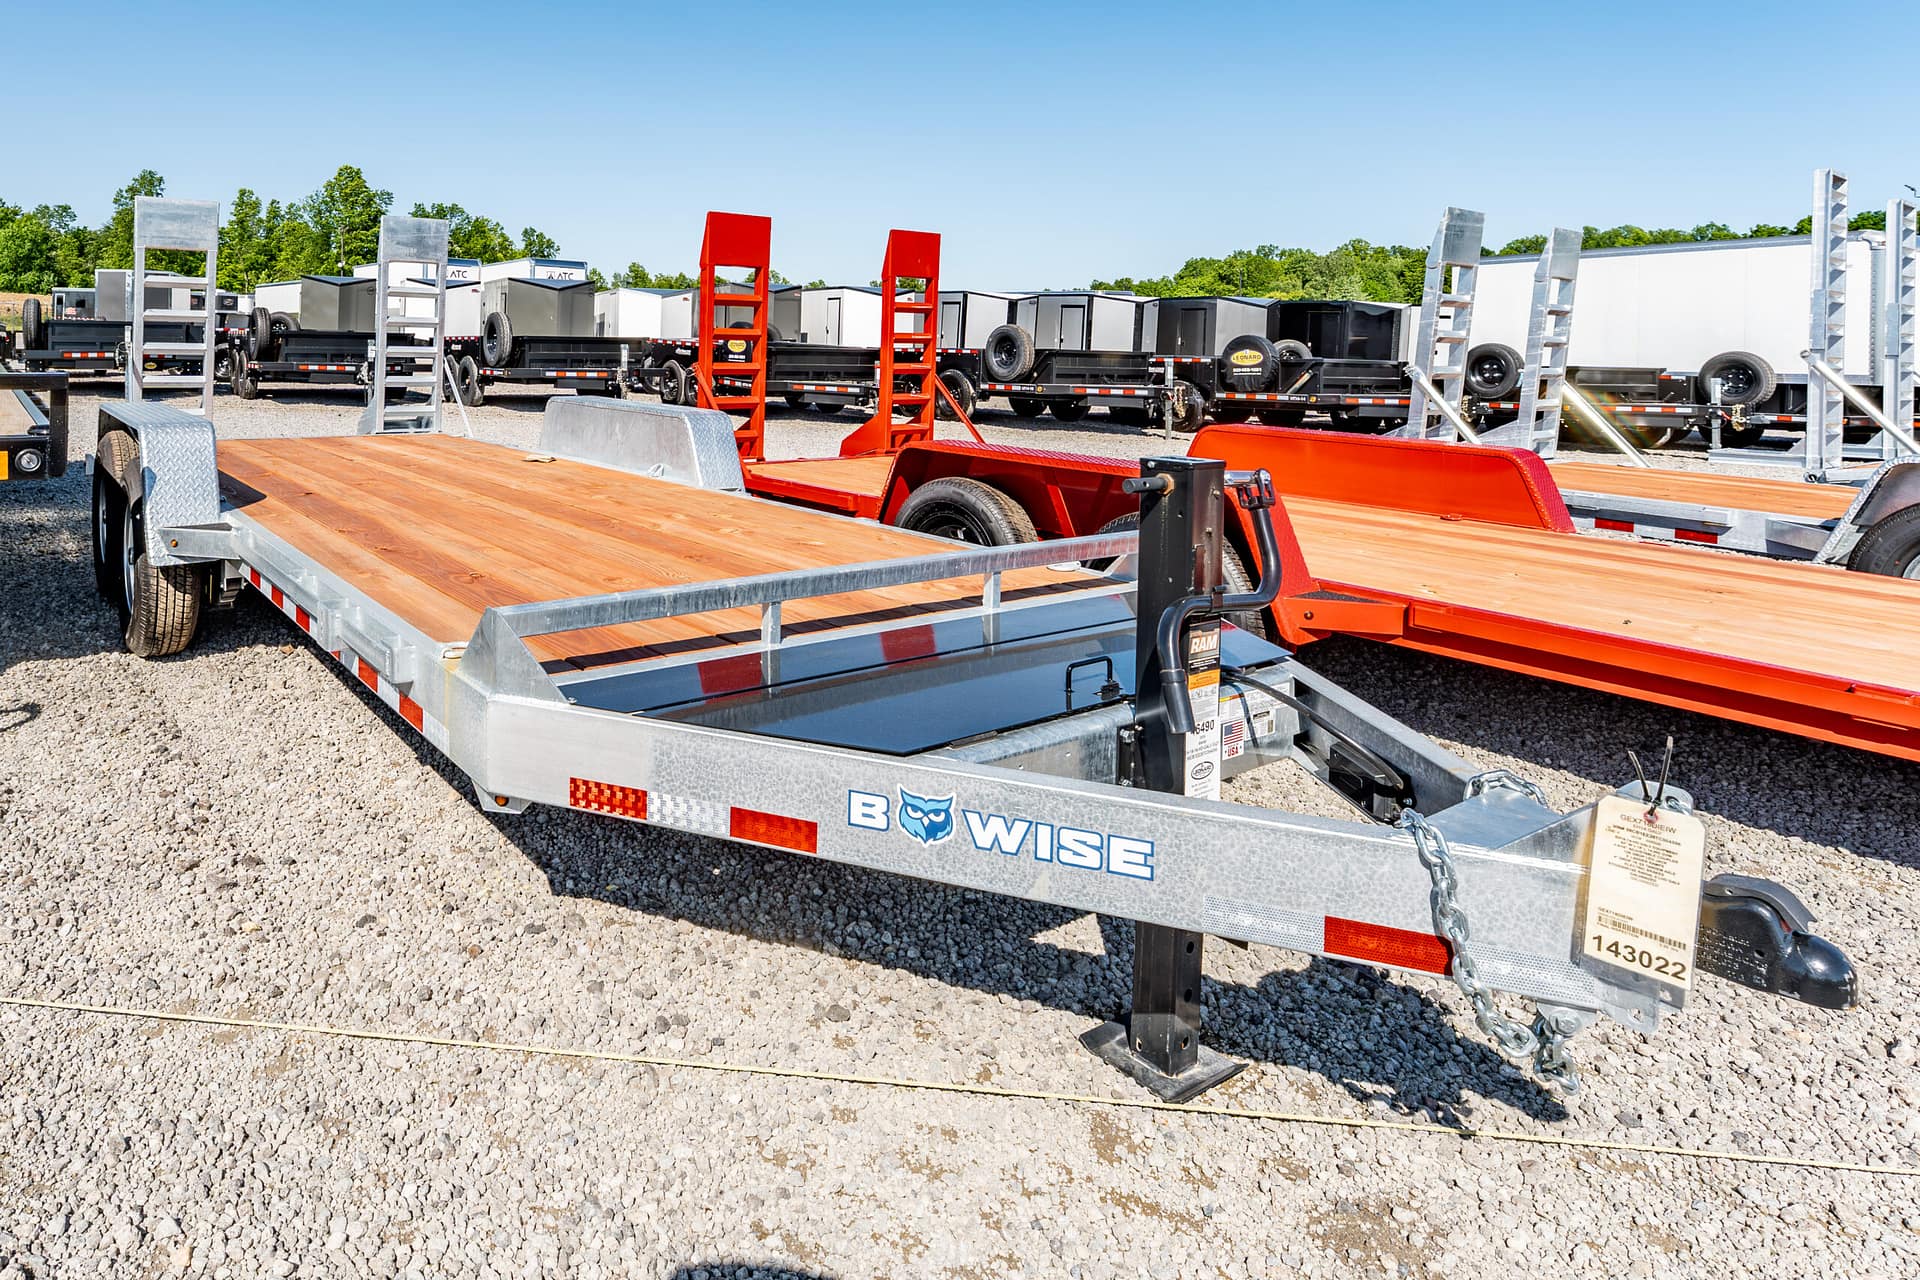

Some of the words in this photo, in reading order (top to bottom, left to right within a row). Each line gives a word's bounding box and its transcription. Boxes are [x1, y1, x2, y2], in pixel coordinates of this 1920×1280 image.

[450, 270, 468, 279] ATC
[557, 271, 574, 281] ATC
[1190, 634, 1218, 654] RAM
[1227, 745, 1239, 757] USA
[1592, 935, 1687, 981] 143022
